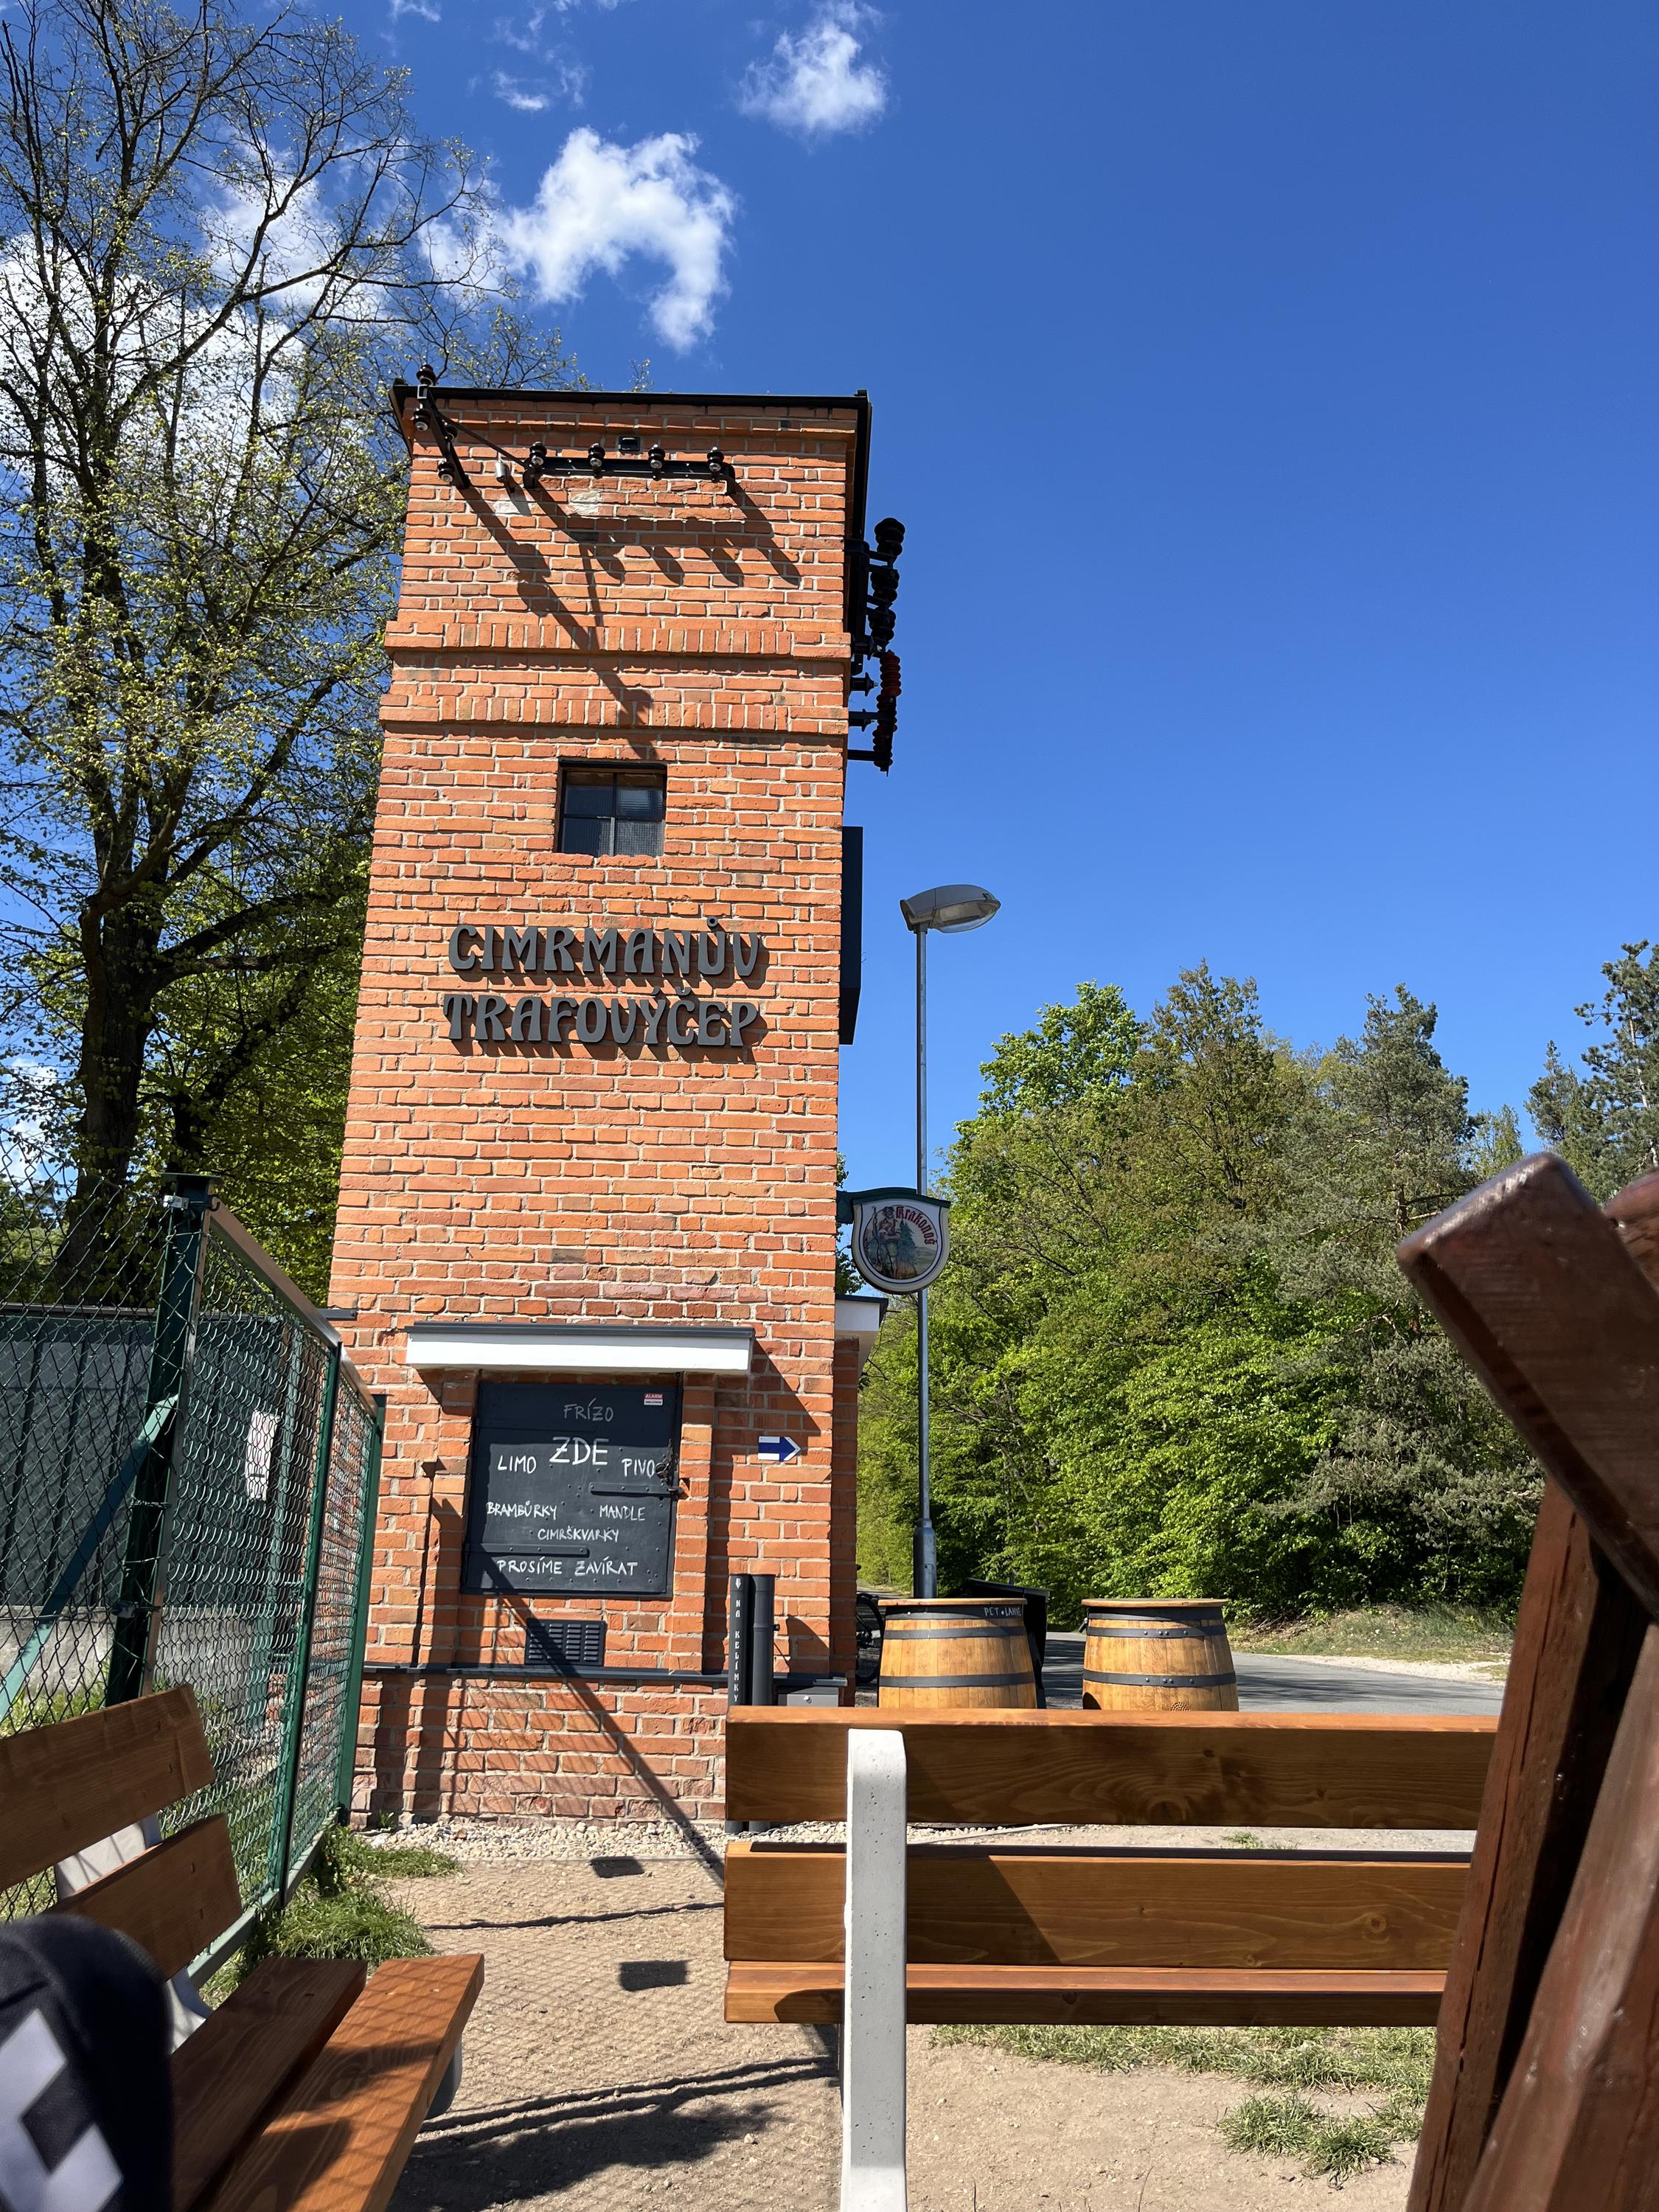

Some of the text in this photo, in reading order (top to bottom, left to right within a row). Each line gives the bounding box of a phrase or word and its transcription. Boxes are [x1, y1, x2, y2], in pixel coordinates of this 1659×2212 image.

[448, 916, 759, 977] CIMRMANŮV
[443, 986, 758, 1046] TRAFOVÝČEP
[563, 1397, 614, 1422] FRÍZO
[549, 1436, 609, 1465] ZDE
[498, 1455, 537, 1474] LIMO
[622, 1458, 655, 1476] PIVO
[487, 1500, 557, 1520] BRAMBŮRKY
[599, 1505, 646, 1521] MANDLE
[538, 1526, 619, 1543] CIMRŠKVARKY
[497, 1556, 639, 1576] PROSÍME ZAVÍRAT
[735, 1599, 741, 1618] NA
[984, 1607, 999, 1616] PET
